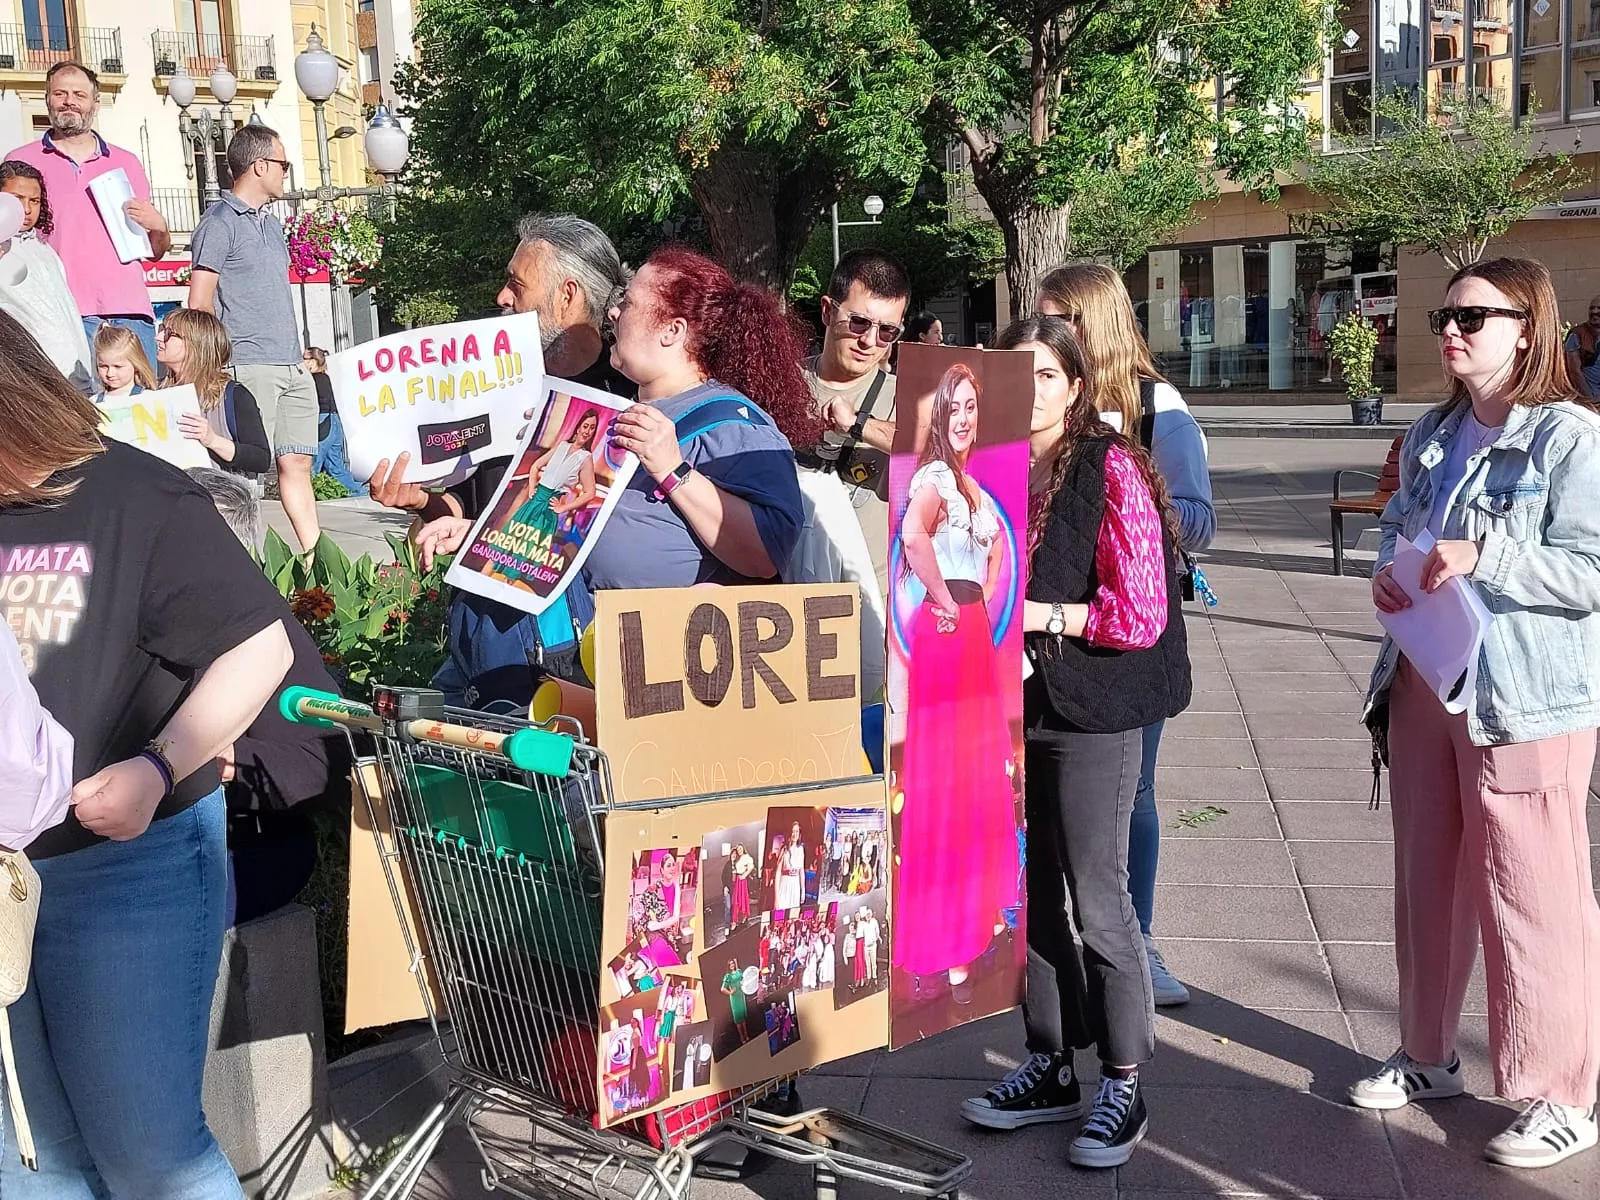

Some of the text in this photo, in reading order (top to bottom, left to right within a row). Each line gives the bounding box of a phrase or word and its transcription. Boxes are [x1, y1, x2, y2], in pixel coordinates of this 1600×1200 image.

[1560, 207, 1597, 217] GRANJA
[358, 329, 513, 380] LORENA A
[358, 352, 523, 416] LA FINAL!!!
[426, 423, 486, 447] JOTALENT
[480, 528, 565, 572] LORENA MATA
[508, 520, 553, 549] VOTA A
[6, 546, 90, 573] MATA
[472, 544, 559, 583] GANADORA JOTALENT
[0, 574, 83, 608] JOTA
[619, 595, 855, 720] LORE
